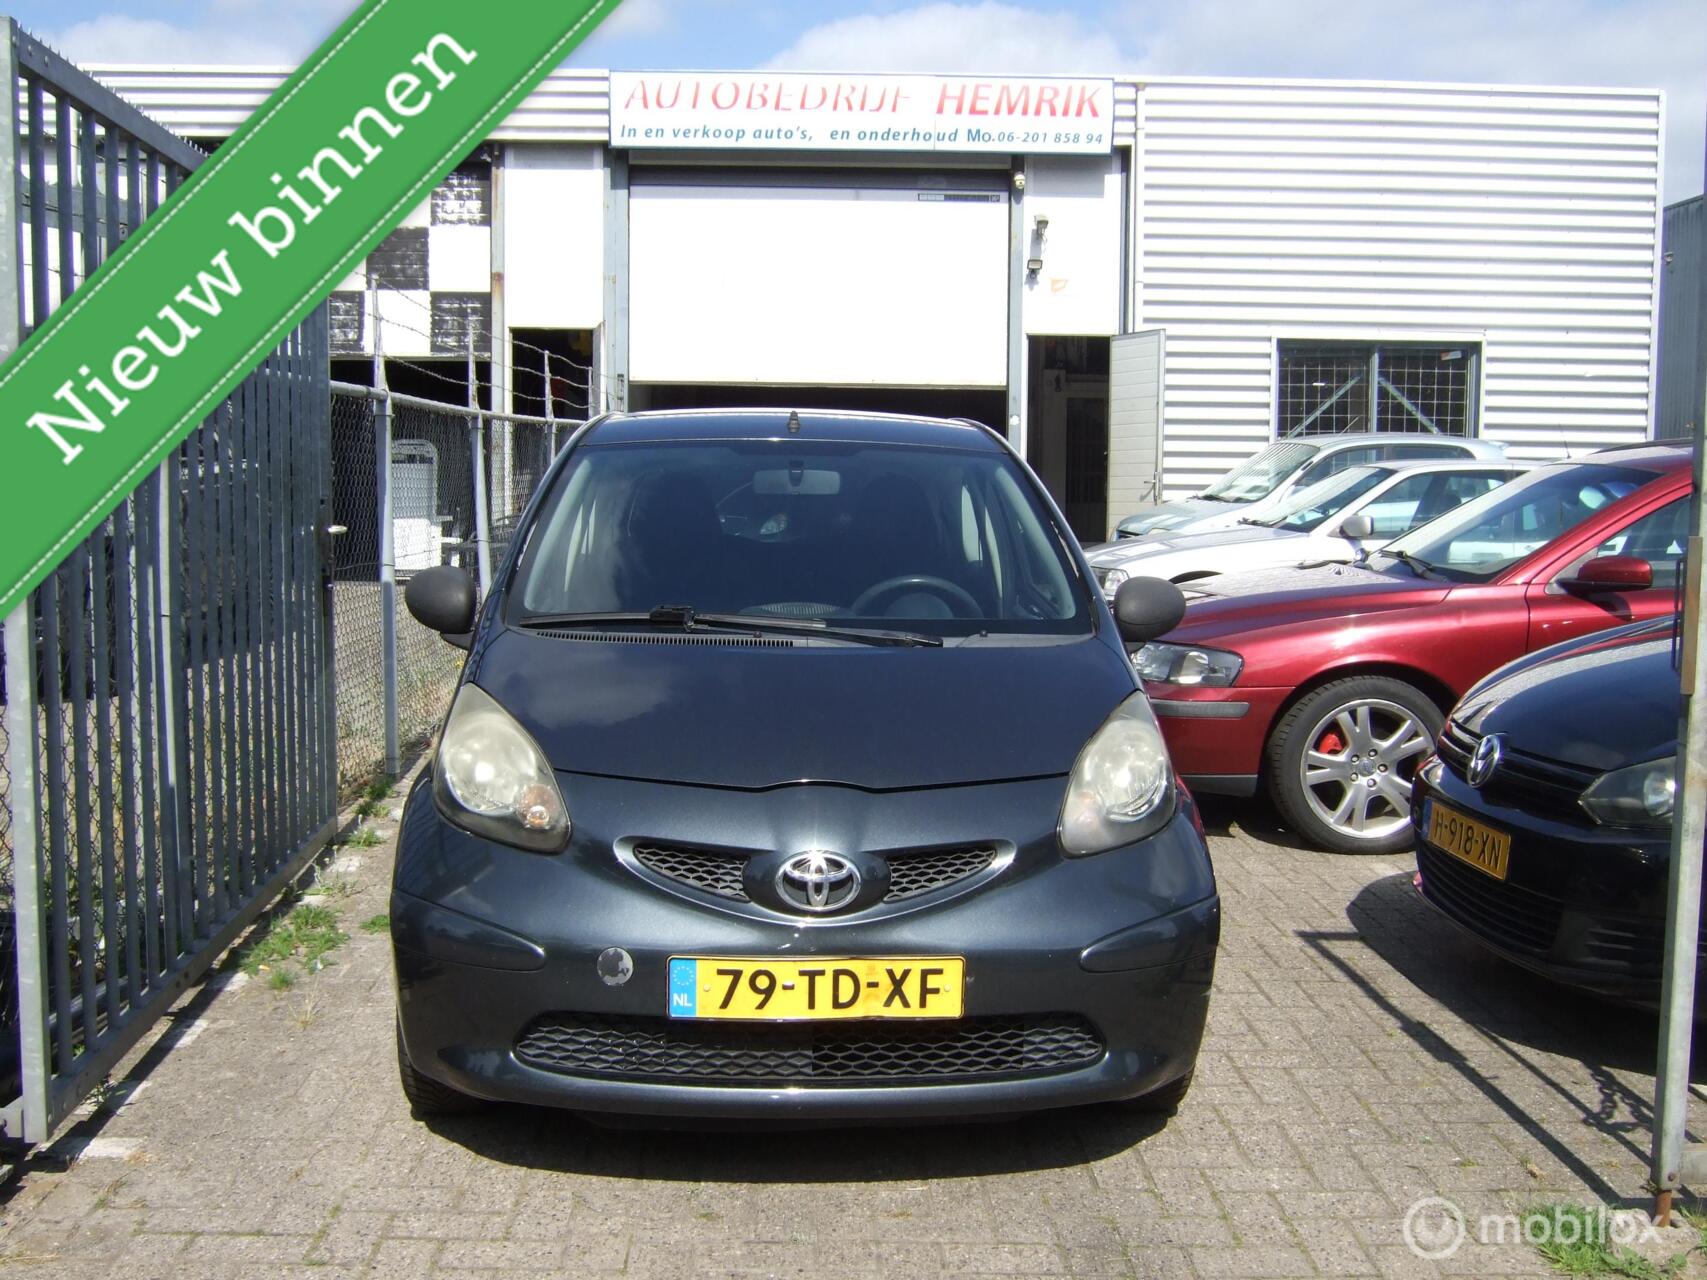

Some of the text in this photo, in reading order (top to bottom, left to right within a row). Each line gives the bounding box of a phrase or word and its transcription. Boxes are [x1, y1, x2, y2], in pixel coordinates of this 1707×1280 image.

[936, 83, 1101, 117] HEMRIK
[620, 124, 637, 138] In
[644, 126, 664, 139] en
[672, 125, 746, 142] verkoop
[753, 125, 813, 142] auto's,
[830, 128, 850, 140] en
[857, 127, 958, 142] onderhoud
[1054, 131, 1081, 144] 858
[1086, 133, 1103, 144] 94
[1434, 810, 1502, 871] H-918-XN
[672, 993, 692, 1007] NL
[716, 968, 944, 1010] 79-TD-XF
